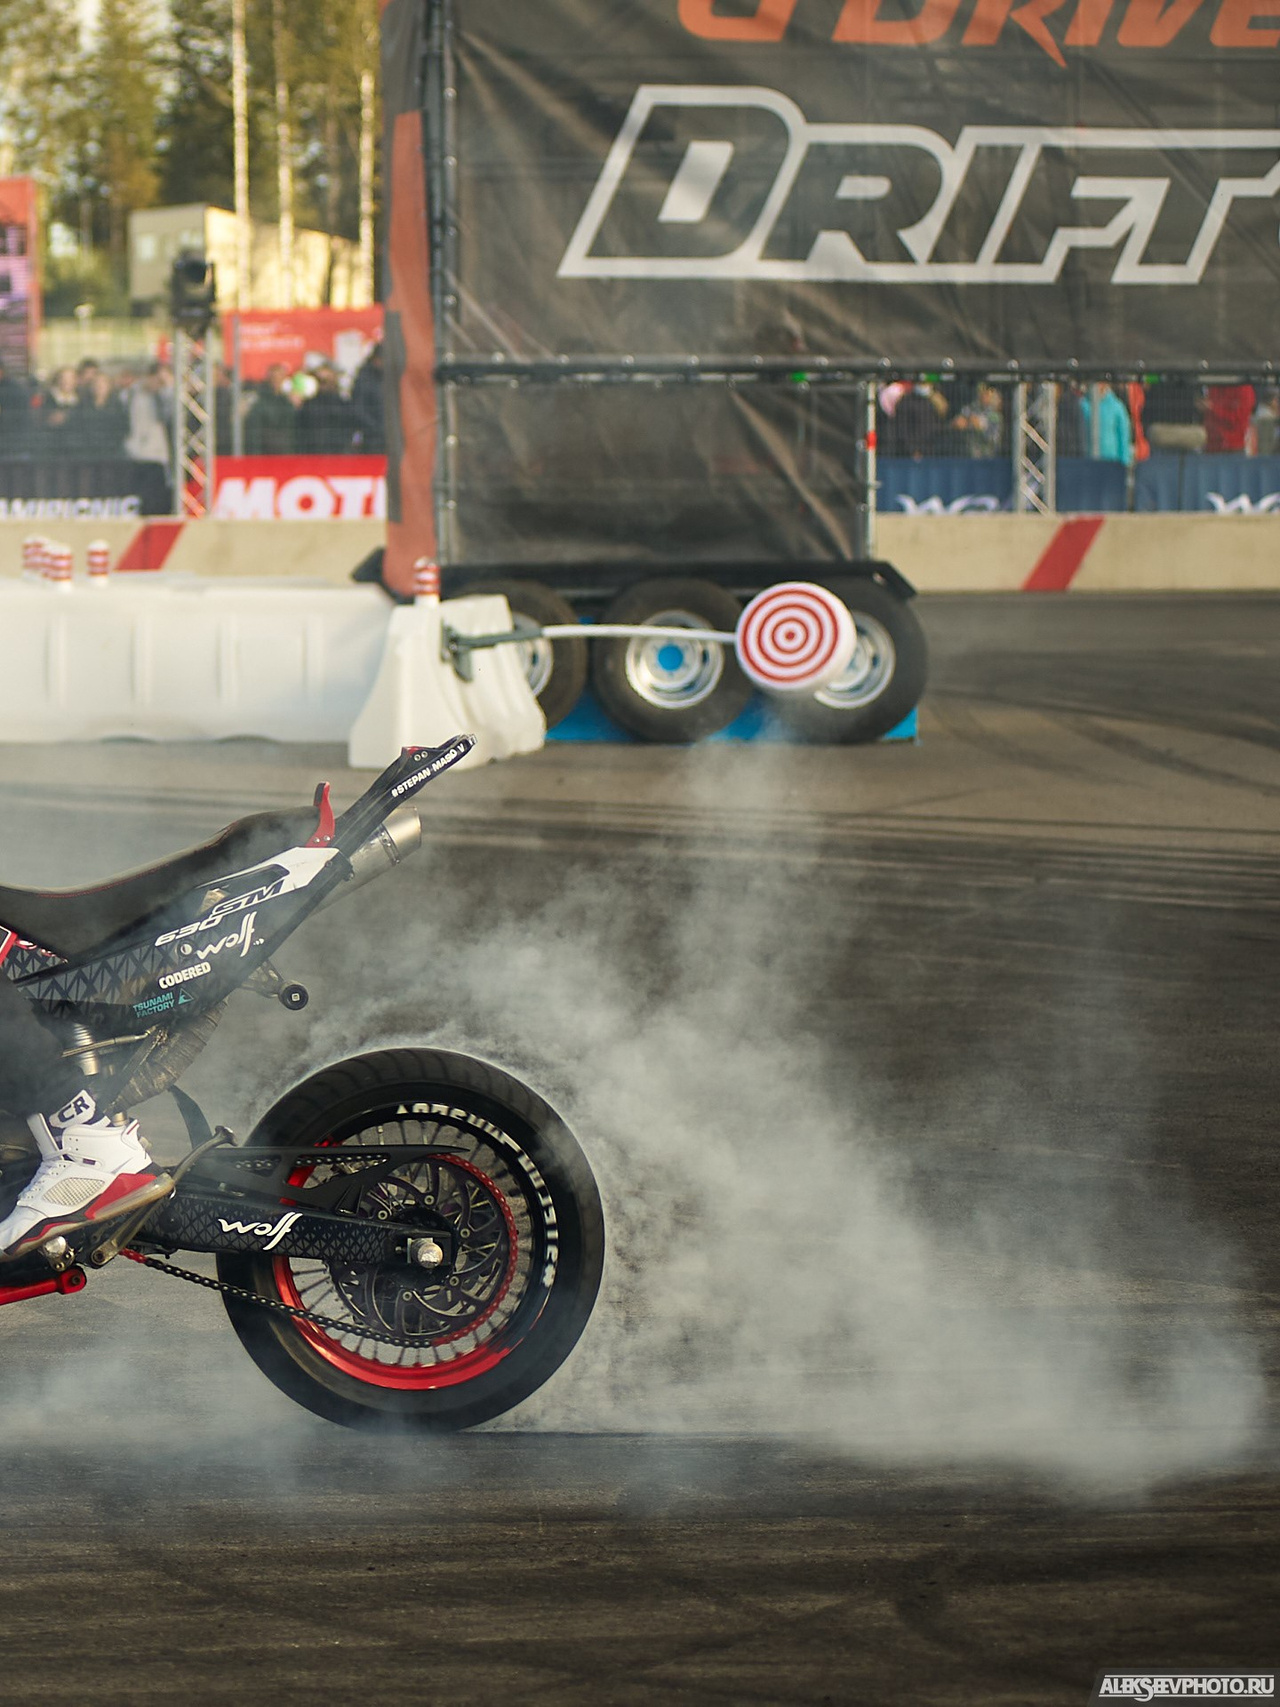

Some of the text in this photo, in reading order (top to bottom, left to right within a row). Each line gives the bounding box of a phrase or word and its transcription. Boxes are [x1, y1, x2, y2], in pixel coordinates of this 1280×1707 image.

[196, 911, 260, 960] wolf
[158, 961, 212, 989] CODERED
[132, 991, 174, 1013] TSUNAMI
[136, 999, 175, 1019] FACTORY
[57, 1095, 91, 1123] CR
[217, 1211, 304, 1251] wolf
